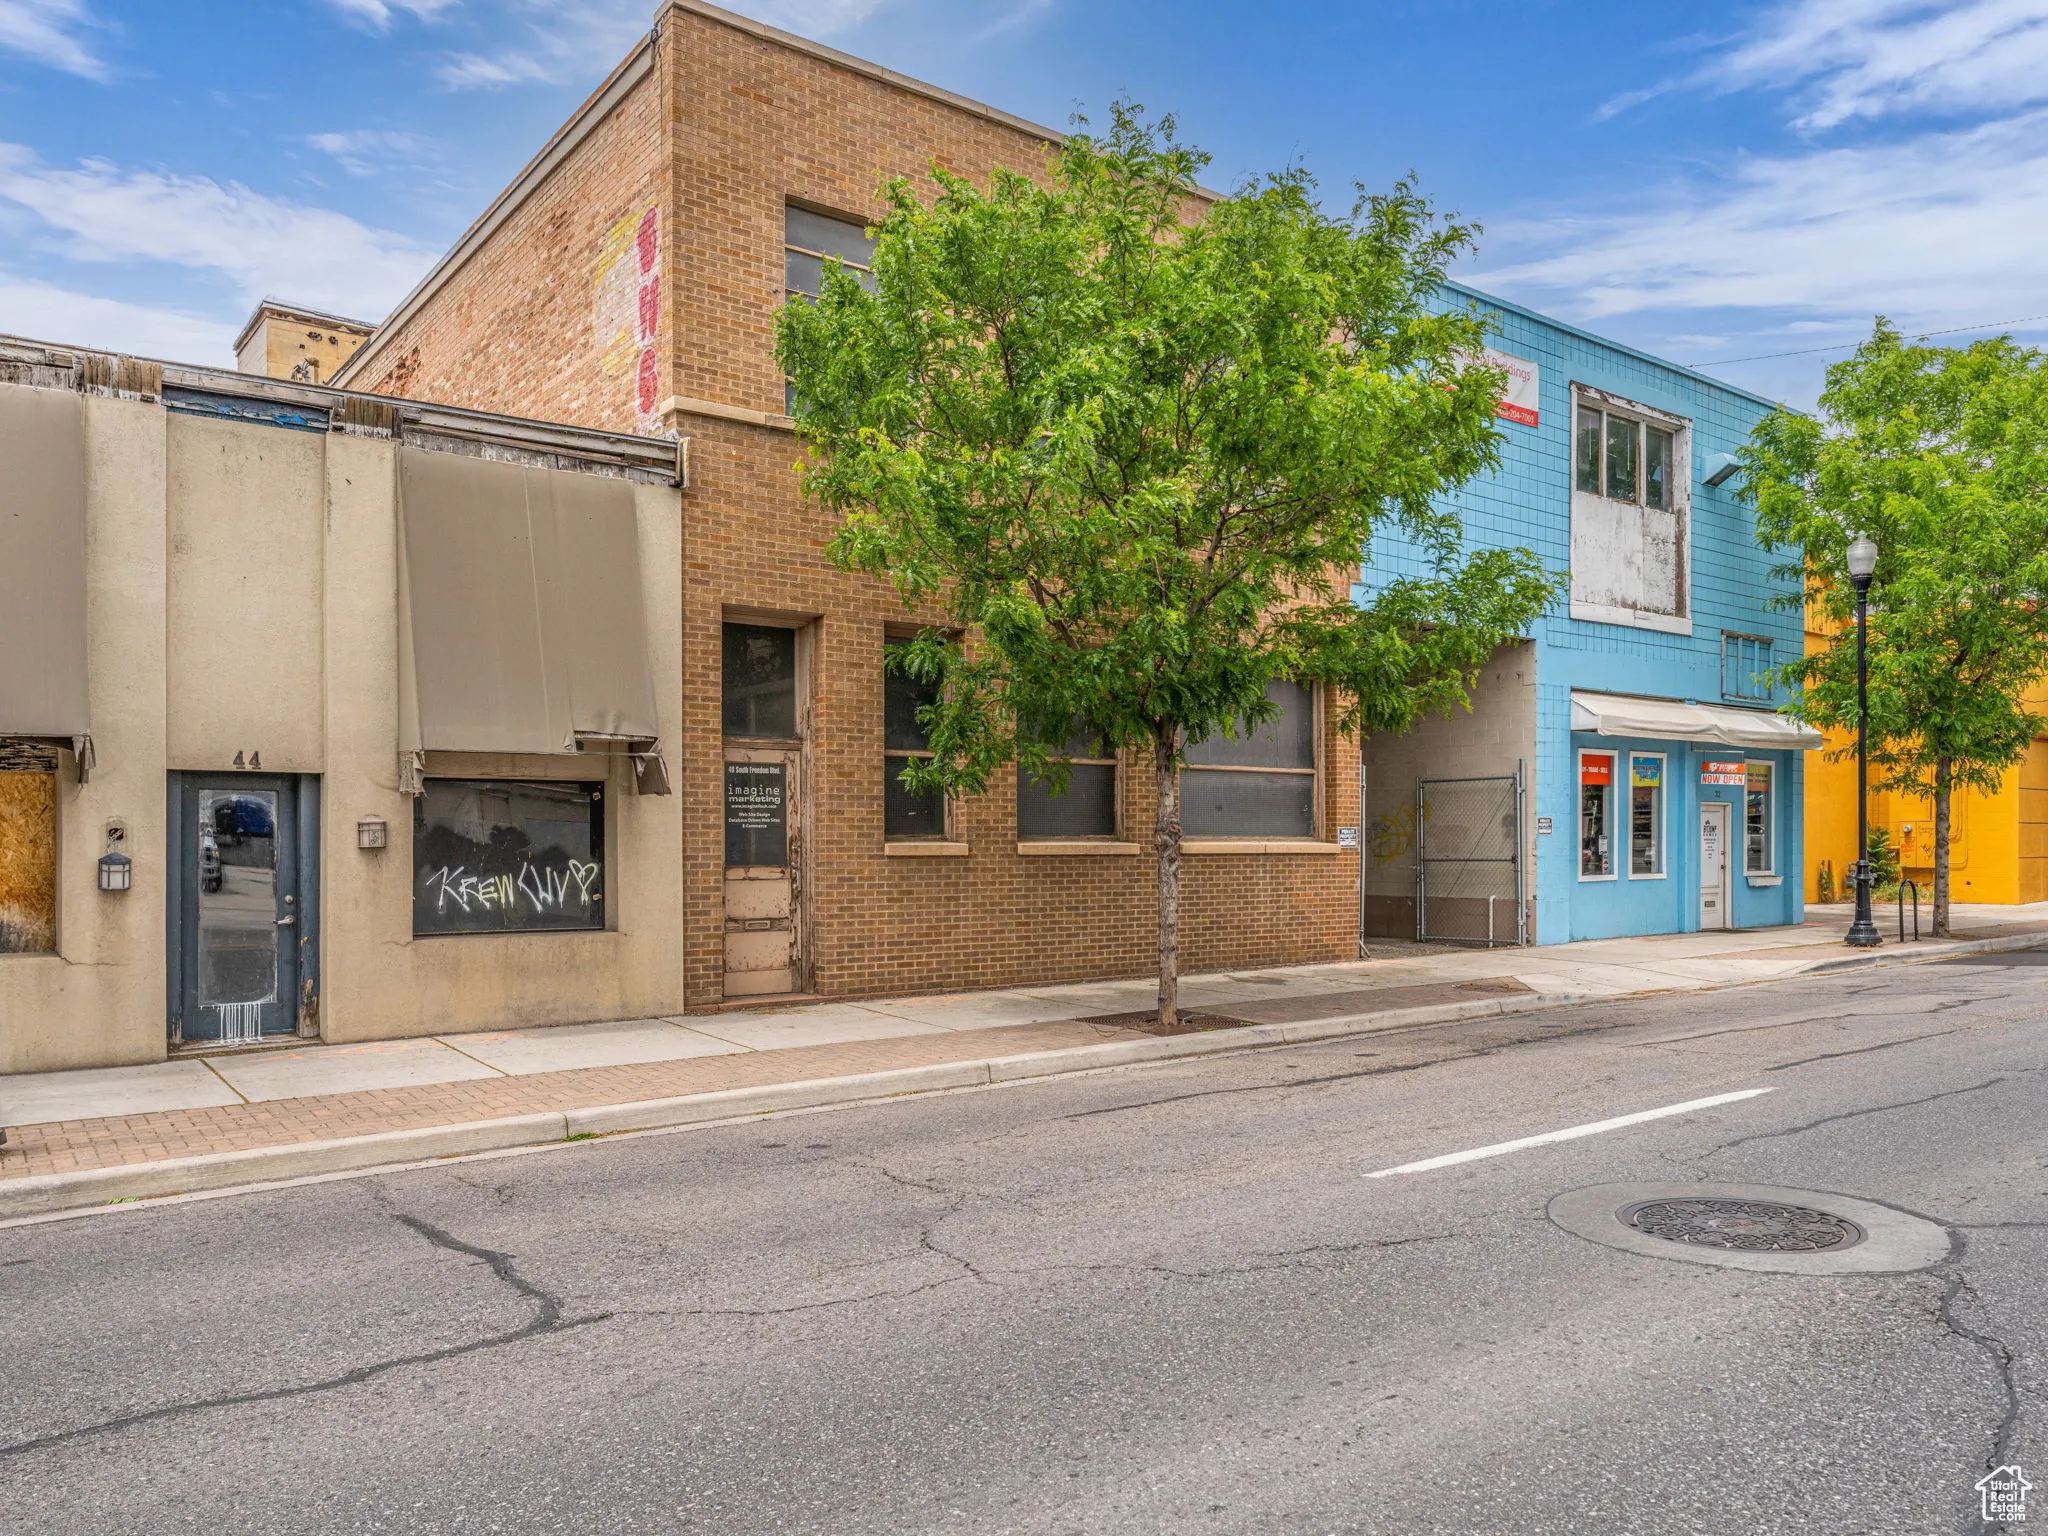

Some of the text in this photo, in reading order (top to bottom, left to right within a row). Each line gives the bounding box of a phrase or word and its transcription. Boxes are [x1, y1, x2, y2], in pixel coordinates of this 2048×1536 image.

[232, 750, 262, 770] 44
[735, 766, 749, 774] South
[749, 766, 769, 774] Freedom
[1702, 774, 1720, 784] NOW
[1723, 774, 1743, 785] OPEN
[728, 783, 780, 797] imagine
[728, 795, 781, 805] marketing
